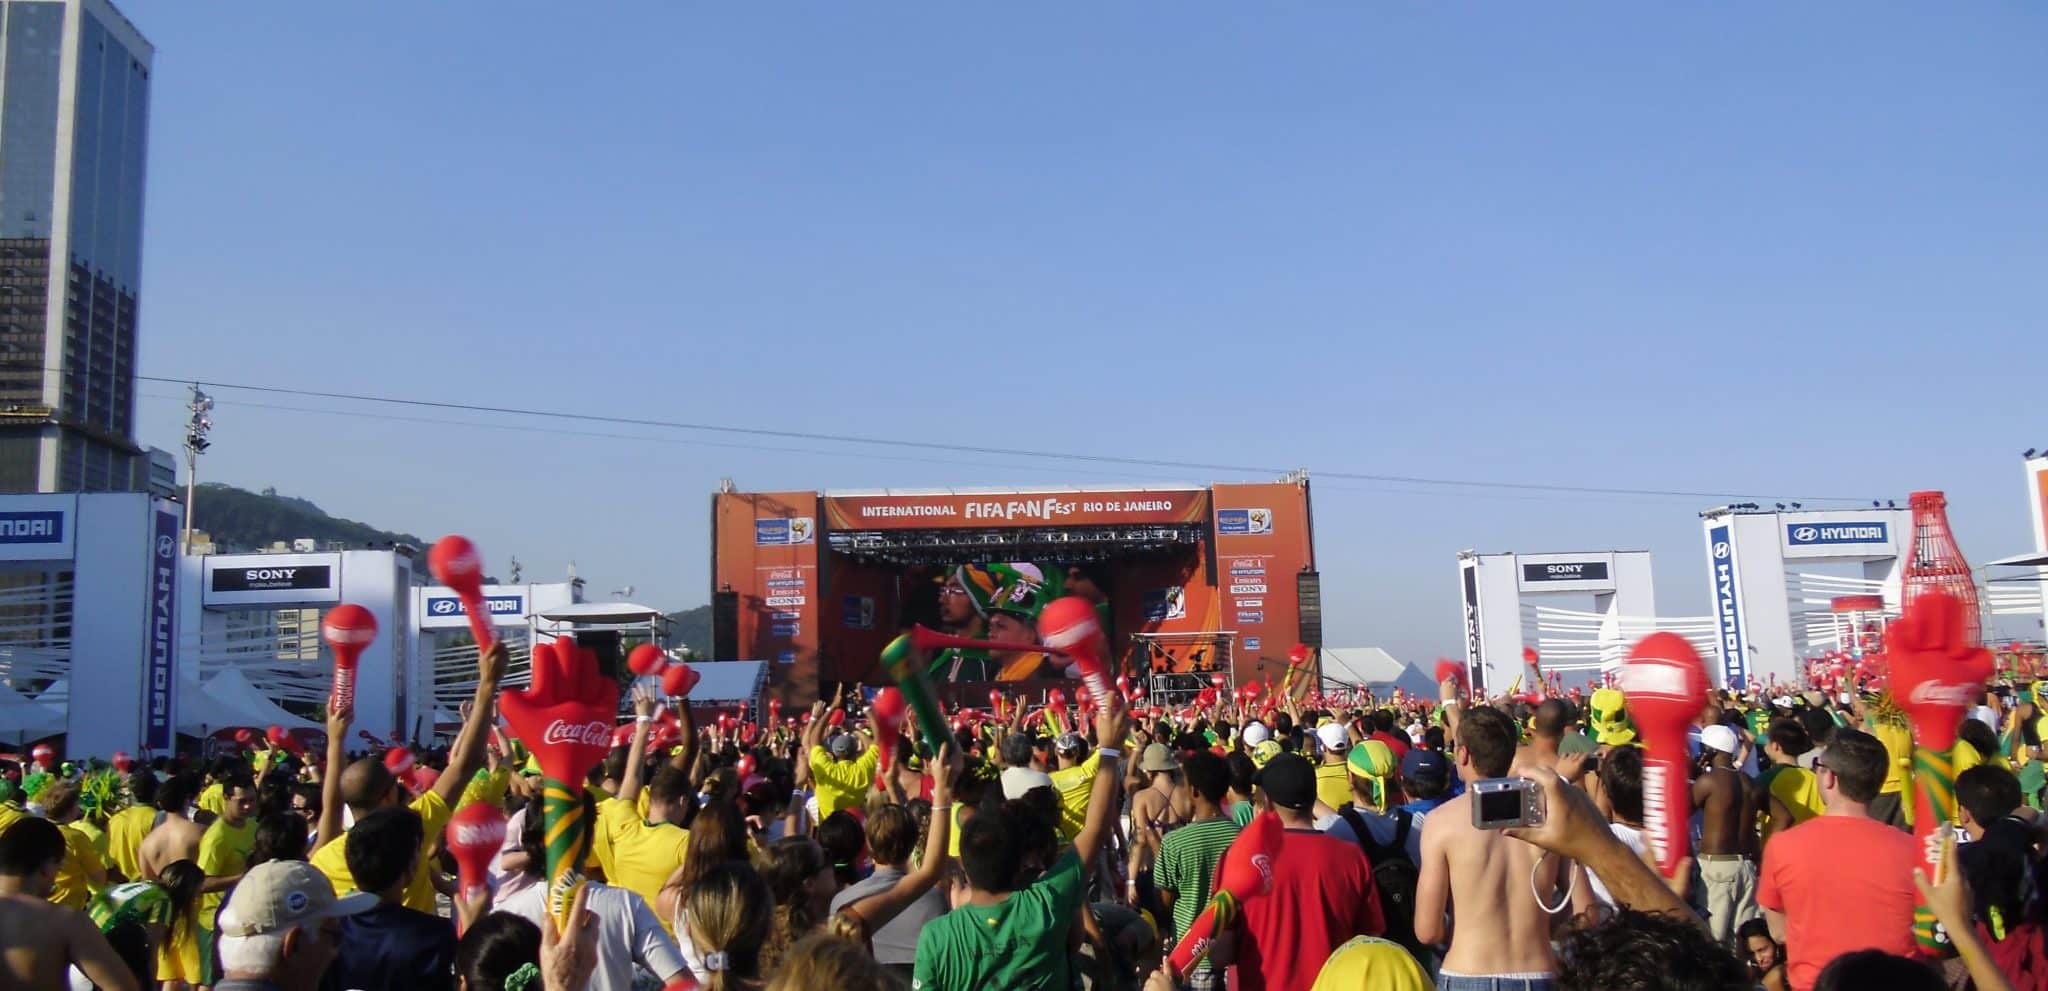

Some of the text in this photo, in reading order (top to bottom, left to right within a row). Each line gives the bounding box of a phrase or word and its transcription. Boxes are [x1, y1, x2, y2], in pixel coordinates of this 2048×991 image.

[862, 505, 957, 517] INTERNATIONAL
[964, 502, 1005, 519] FIFA
[1083, 502, 1103, 513] RIO
[1106, 501, 1121, 512] DE
[1123, 500, 1173, 512] JANEIRO
[1820, 527, 1882, 539] HYUNDAI
[246, 569, 297, 580] SONY
[1546, 564, 1584, 574] SONY
[1718, 563, 1740, 676] HYUNDAI
[1467, 601, 1478, 668] SONY
[153, 567, 170, 727] HYUNDAI
